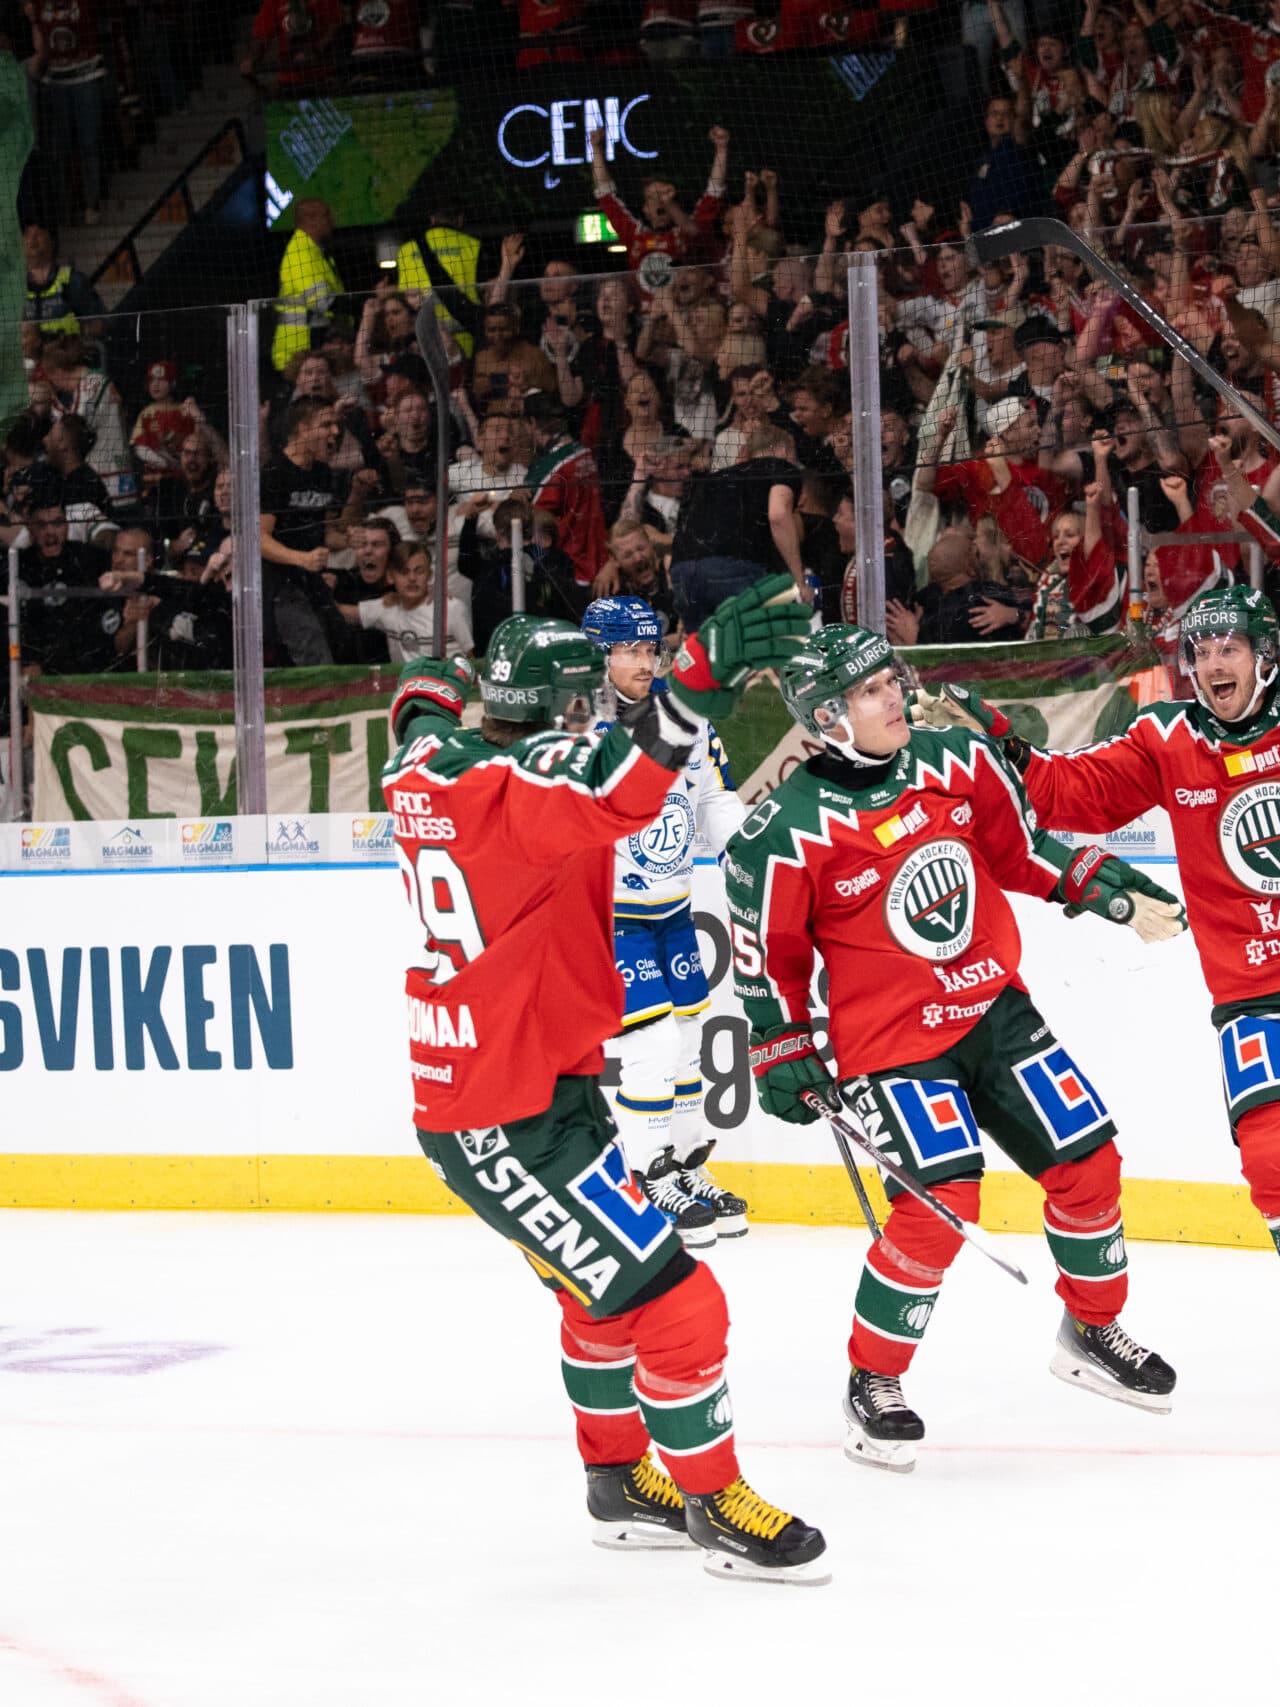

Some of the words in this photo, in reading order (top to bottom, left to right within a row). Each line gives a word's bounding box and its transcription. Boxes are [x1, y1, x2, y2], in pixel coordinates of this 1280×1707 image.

[490, 660, 512, 682] 39
[1222, 794, 1254, 837] FRÖLUNDA
[266, 841, 320, 852] HAGMANS
[352, 838, 395, 849] HAGMA
[1105, 831, 1156, 842] HAGMANS
[21, 847, 71, 857] HAGMANS
[102, 845, 153, 856] HAGMANS
[182, 843, 233, 854] HAGMANS
[890, 860, 919, 911] FRÖLUNDA
[919, 843, 955, 863] HOCKEY
[939, 957, 1006, 993] RASTA
[734, 984, 768, 999] mblin
[945, 997, 997, 1020] Tranp
[408, 995, 478, 1048] OMAA
[749, 1033, 812, 1067] AUER
[806, 1092, 836, 1119] CCM
[475, 1156, 621, 1300] STENA
